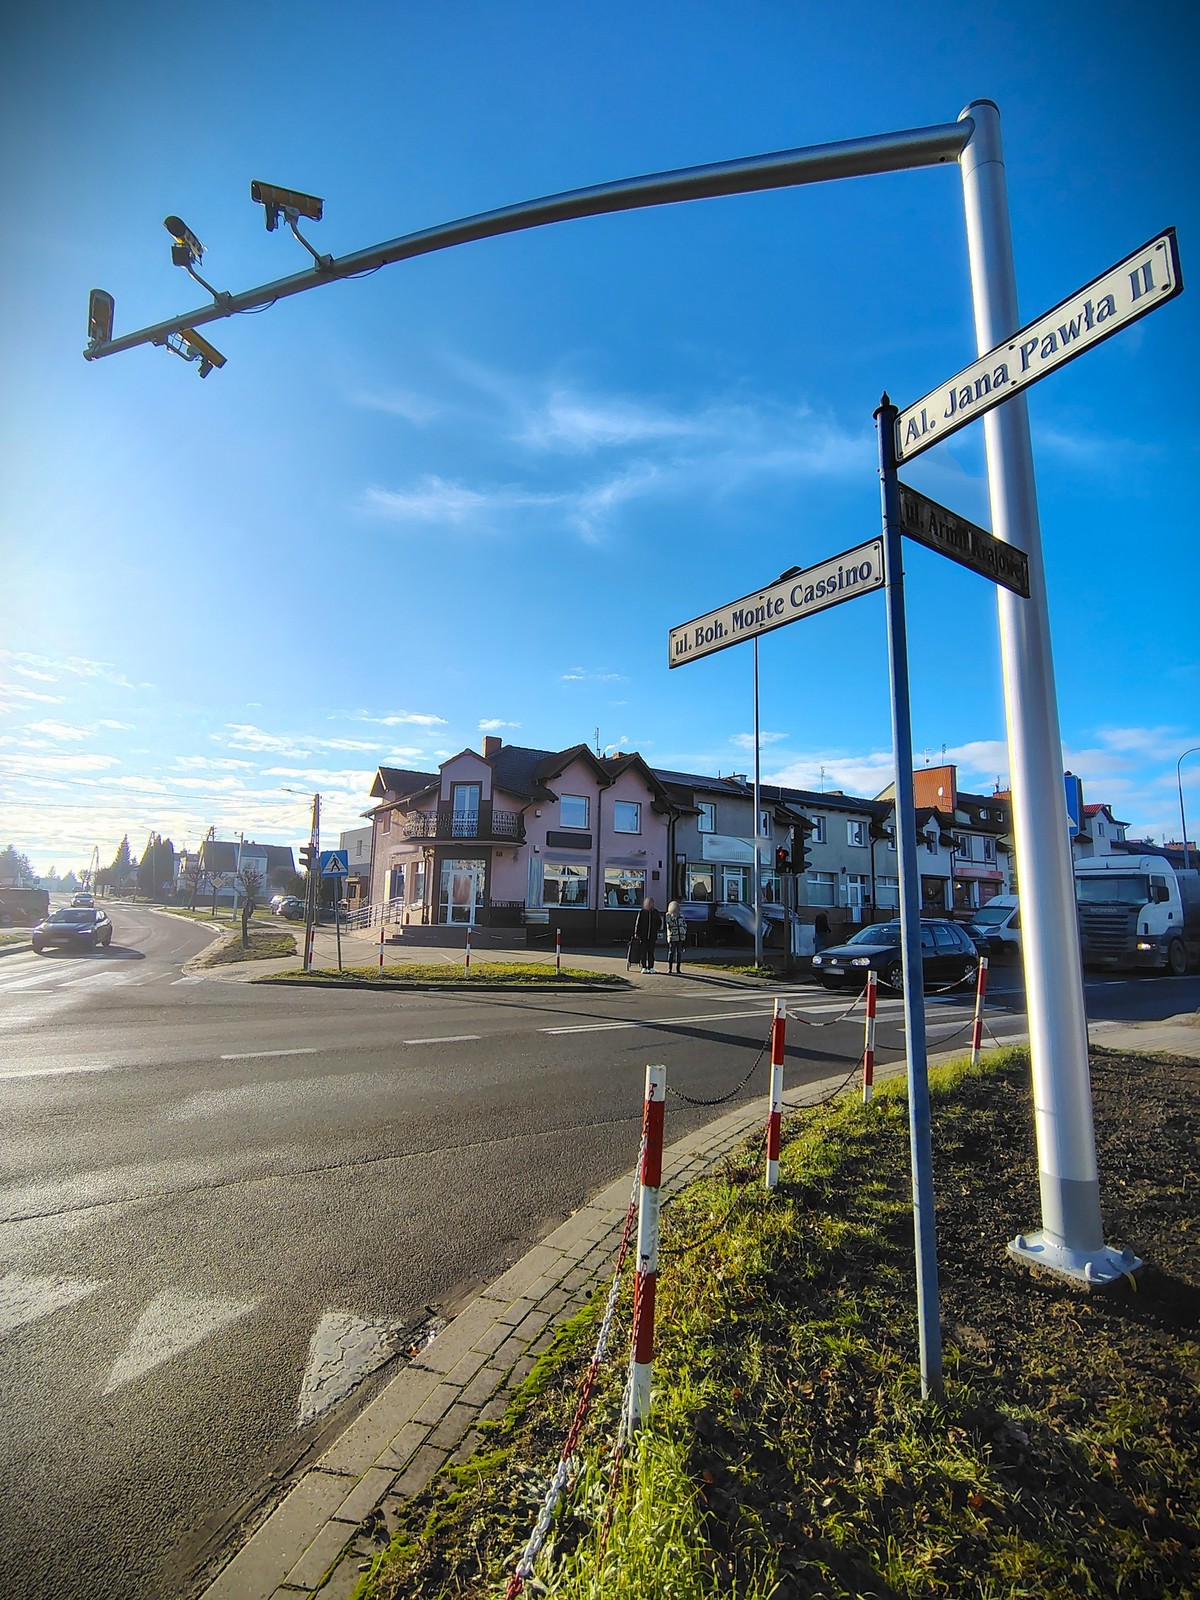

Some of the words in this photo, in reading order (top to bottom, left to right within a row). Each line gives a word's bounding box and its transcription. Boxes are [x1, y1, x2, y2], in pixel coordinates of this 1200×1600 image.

[905, 408, 936, 447] Al.
[943, 363, 1010, 419] Jana
[1019, 293, 1118, 373] Pawła
[1128, 259, 1157, 303] II
[905, 502, 925, 529] ul.
[675, 633, 692, 656] ul.
[694, 620, 729, 647] Boh.
[732, 597, 785, 632] Monte
[790, 560, 873, 608] Cassino
